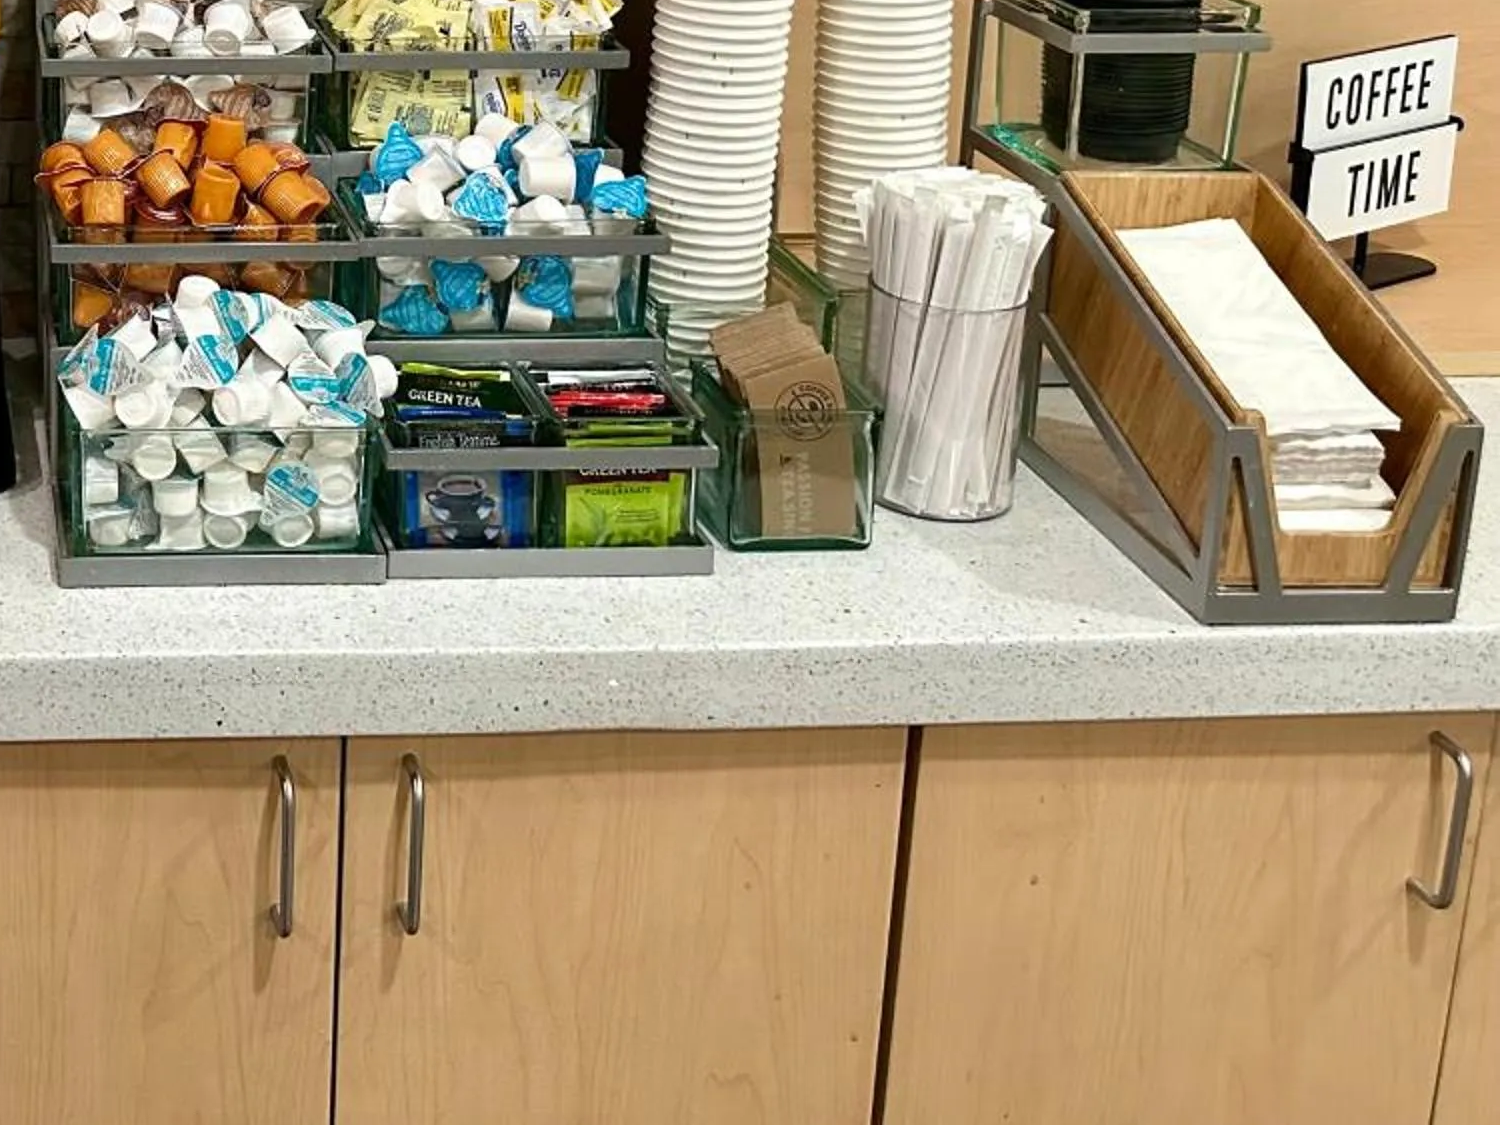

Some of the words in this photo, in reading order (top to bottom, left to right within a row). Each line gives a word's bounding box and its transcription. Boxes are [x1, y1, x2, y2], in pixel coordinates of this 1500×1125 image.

[1326, 59, 1435, 130] COFFEE
[1347, 150, 1421, 218] TIME
[408, 388, 453, 405] GREEN
[455, 394, 482, 408] TEA
